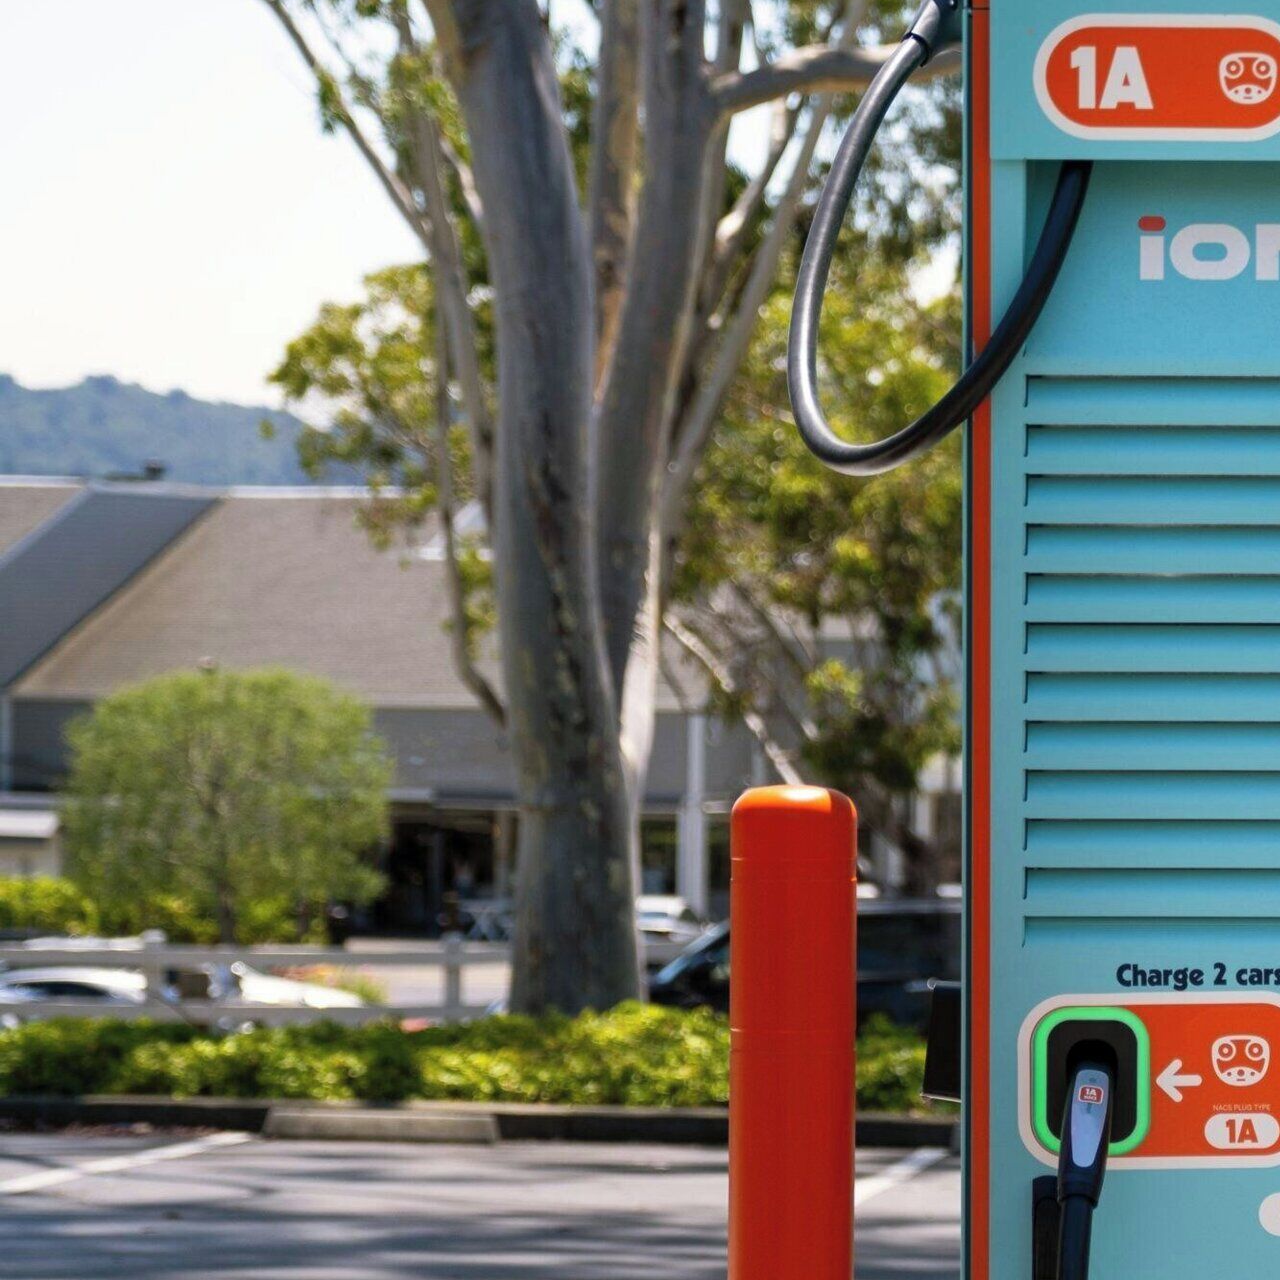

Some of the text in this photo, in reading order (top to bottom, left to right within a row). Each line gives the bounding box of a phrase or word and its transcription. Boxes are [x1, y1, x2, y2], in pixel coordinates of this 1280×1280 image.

[1069, 46, 1154, 110] 1A
[1116, 963, 1204, 991] Charge
[1213, 962, 1228, 986] 2
[1213, 1104, 1233, 1112] NACS
[1225, 1118, 1259, 1144] 1A
